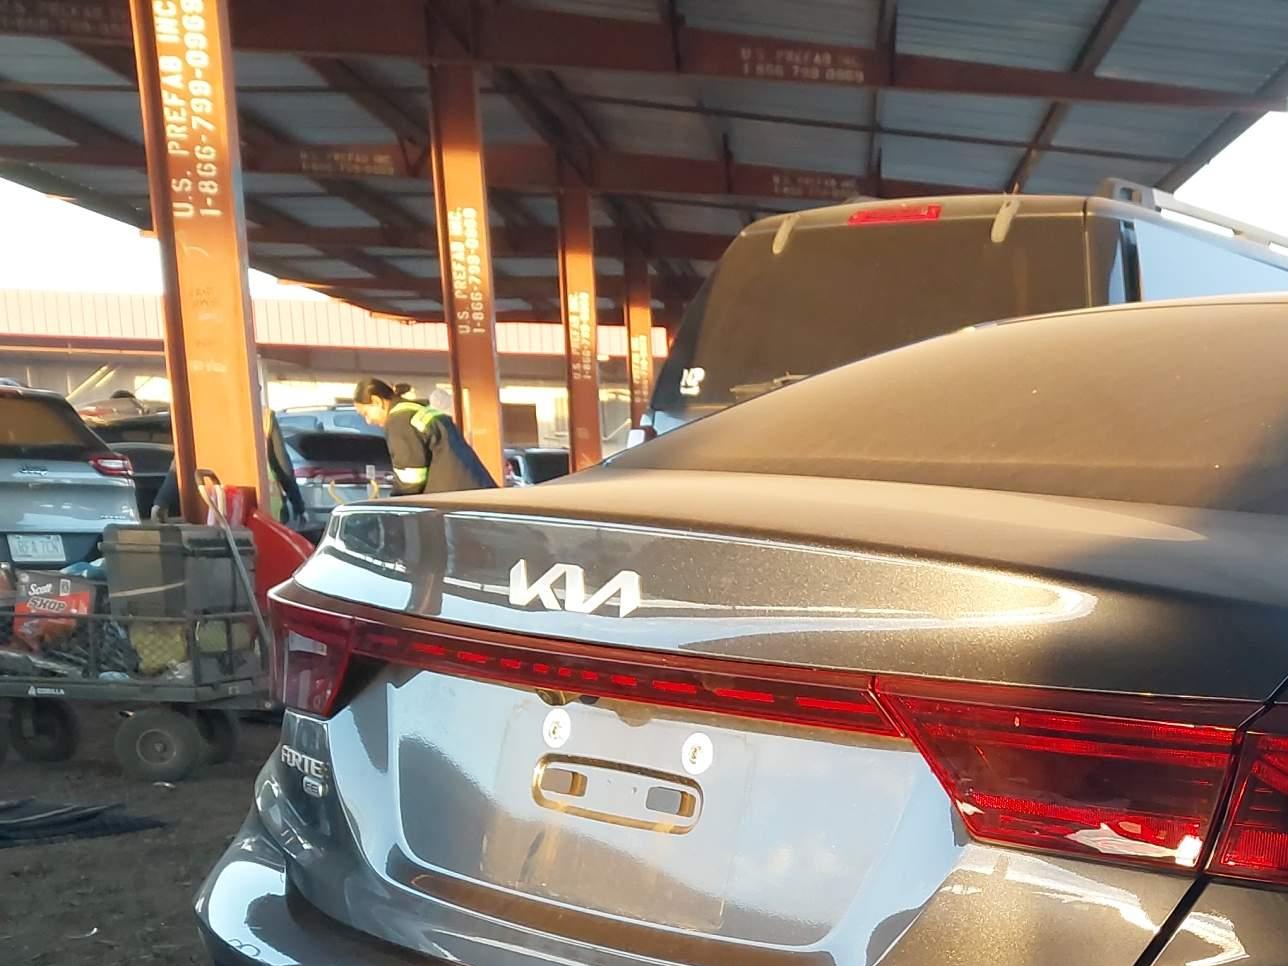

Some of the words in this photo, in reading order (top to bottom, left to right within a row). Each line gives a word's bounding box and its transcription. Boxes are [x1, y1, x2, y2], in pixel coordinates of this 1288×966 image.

[171, 170, 195, 218] U.S.
[29, 597, 67, 612] SHOP
[509, 558, 641, 618] KIA
[281, 745, 325, 779] FORTE
